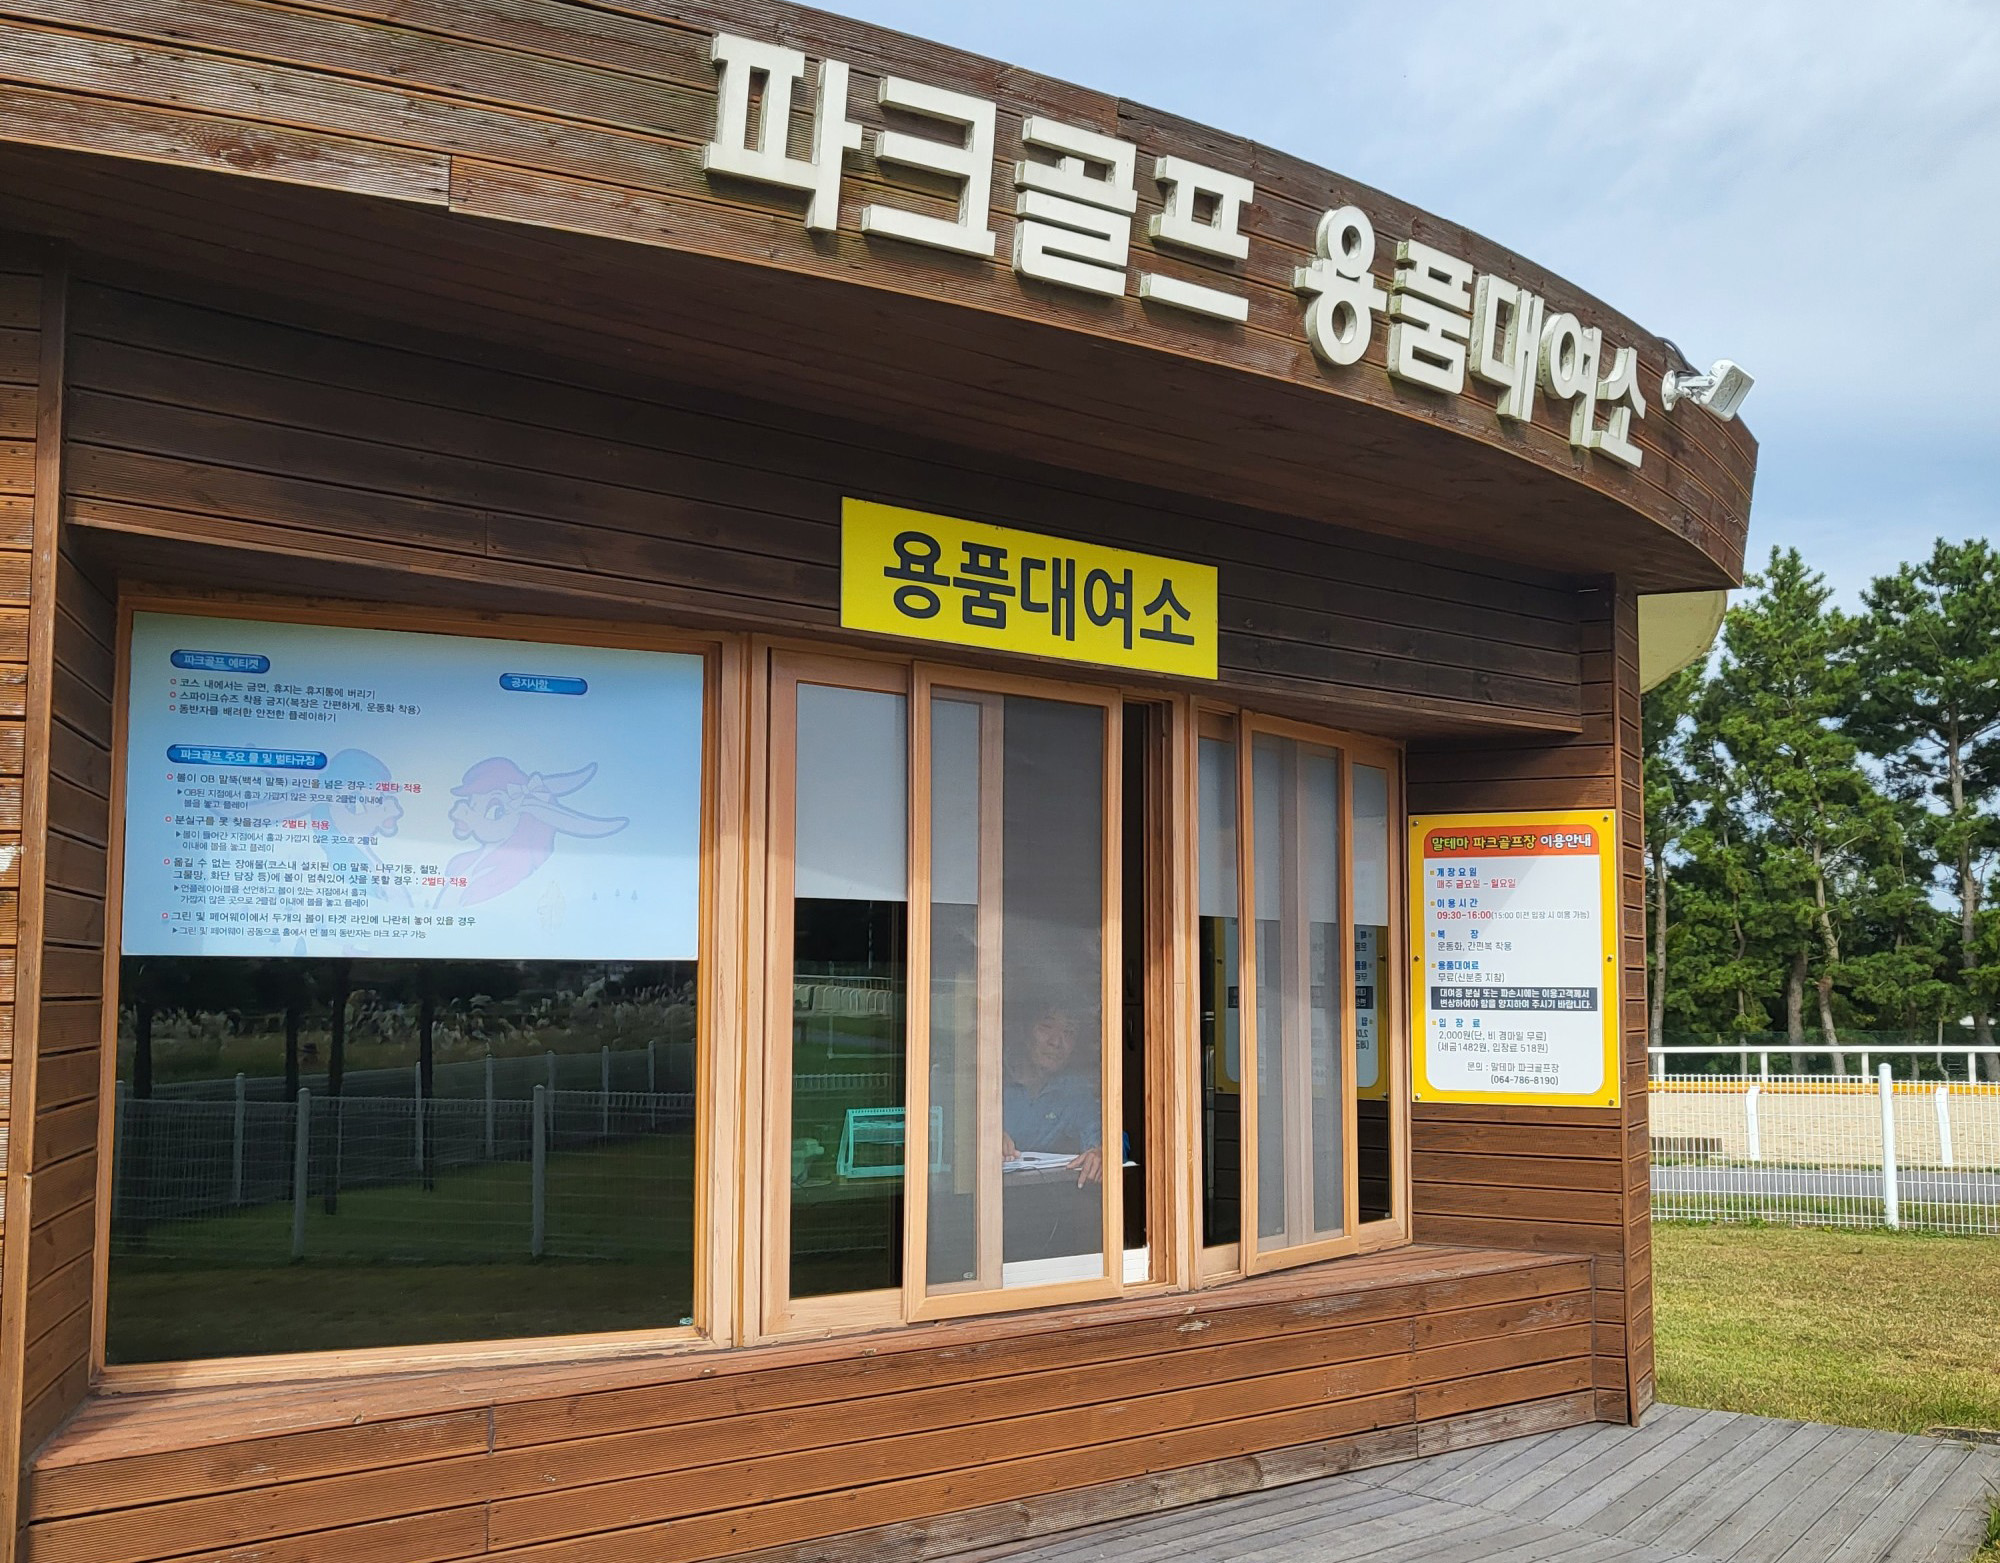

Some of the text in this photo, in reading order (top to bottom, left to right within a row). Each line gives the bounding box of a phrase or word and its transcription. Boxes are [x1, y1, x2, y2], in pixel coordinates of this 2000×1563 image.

[701, 32, 1647, 470] 파크골프 용품대여소
[883, 529, 1196, 650] 용품대여소
[184, 655, 226, 666] 파크골프
[180, 678, 201, 688] 코스
[204, 680, 244, 691] 내에서는
[274, 684, 303, 695] 휴지는
[306, 686, 344, 697] 휴지통에
[347, 689, 376, 700] 버리기
[511, 678, 549, 691] 공지사항
[180, 692, 239, 703] 스파이크슈즈
[243, 695, 262, 706] 착용
[266, 697, 320, 709] 금지(복장은
[322, 700, 363, 711] 간편하게,
[367, 703, 395, 713] 운동화
[179, 704, 337, 722] 동반자를 배려한 안전한 플레이하기
[181, 750, 223, 763] 파크골프
[225, 752, 246, 764] 주요
[263, 754, 273, 764] 및
[276, 755, 316, 766] 벌타규정
[177, 773, 196, 783] 볼이
[200, 774, 216, 784] OB
[219, 775, 262, 786] 말뚝(백색
[266, 777, 288, 787] 말뚝)
[292, 779, 321, 789] 라인을
[324, 780, 344, 790] 넘은
[347, 780, 366, 791] 경우
[404, 784, 422, 794] 적용
[175, 816, 215, 826] 분실구를
[219, 816, 229, 827] 못
[311, 820, 330, 831] 적용
[1432, 833, 1592, 850] 말테마 파크골프장 이용안내
[197, 858, 207, 868] 수
[212, 859, 231, 869] 없는
[302, 862, 329, 872] 설치된
[333, 863, 348, 872] OB
[211, 871, 231, 881] 화단
[234, 872, 255, 882] 담장
[284, 873, 304, 883] 볼이
[371, 876, 390, 885] 못할
[394, 876, 413, 886] 경우
[449, 878, 468, 887] 적용
[1437, 880, 1452, 888] 매주
[1456, 880, 1480, 888] 금요일
[171, 911, 192, 922] 그린
[196, 912, 206, 922] 및
[210, 913, 269, 922] 페어웨이에서
[273, 913, 302, 923] 두개의
[305, 914, 325, 924] 볼이
[328, 914, 348, 924] 타겟
[351, 915, 379, 925] 라인에
[414, 916, 433, 926] 놓여
[436, 916, 454, 926] 있을
[458, 917, 477, 927] 경우
[1468, 942, 1492, 951] 간편복
[1496, 942, 1512, 951] 착용
[1438, 961, 1479, 970] 용품대여료
[1440, 988, 1462, 997] 대여중
[1465, 988, 1480, 997] 분실
[1483, 989, 1498, 998] 또는
[1501, 989, 1540, 998] 파손시에는
[1440, 999, 1478, 1008] 변상하여야
[1498, 1000, 1529, 1008] 양지하여
[1532, 1000, 1555, 1008] 주시기
[1499, 1031, 1524, 1041] 경마일
[1493, 1043, 1518, 1052] 입장료
[1467, 1062, 1559, 1073] 문의 말테마 파크골프장
